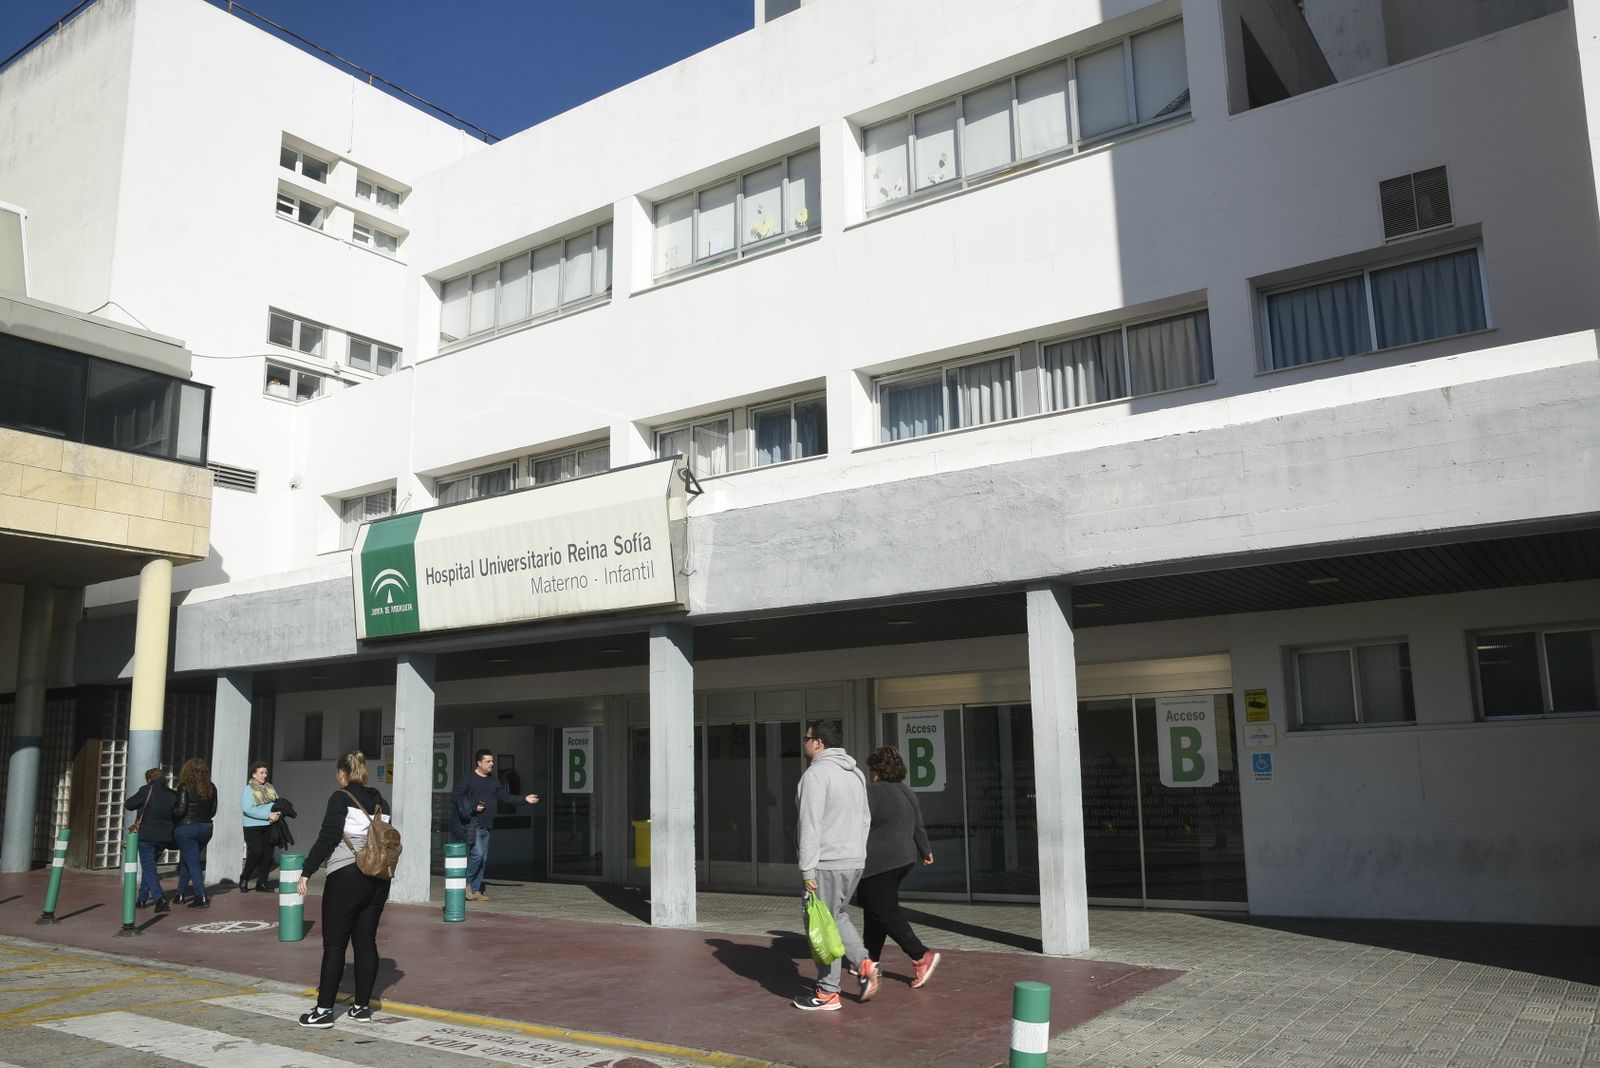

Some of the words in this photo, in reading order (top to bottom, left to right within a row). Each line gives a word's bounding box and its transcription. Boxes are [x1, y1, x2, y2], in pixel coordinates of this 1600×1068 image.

[425, 558, 475, 587] Hospital
[479, 545, 562, 577] Universitario
[567, 541, 608, 564] Reina
[613, 531, 652, 557] Sofía
[530, 573, 588, 595] Materno
[603, 560, 655, 585] Infantil
[905, 723, 937, 734] Acceso
[1165, 710, 1206, 722] Acceso
[567, 736, 589, 746] Acceso
[1169, 726, 1206, 782] B
[432, 752, 448, 790] B
[568, 749, 587, 789] B
[908, 738, 936, 787] B
[414, 1034, 479, 1051] VIDA
[529, 1043, 596, 1059] dona
